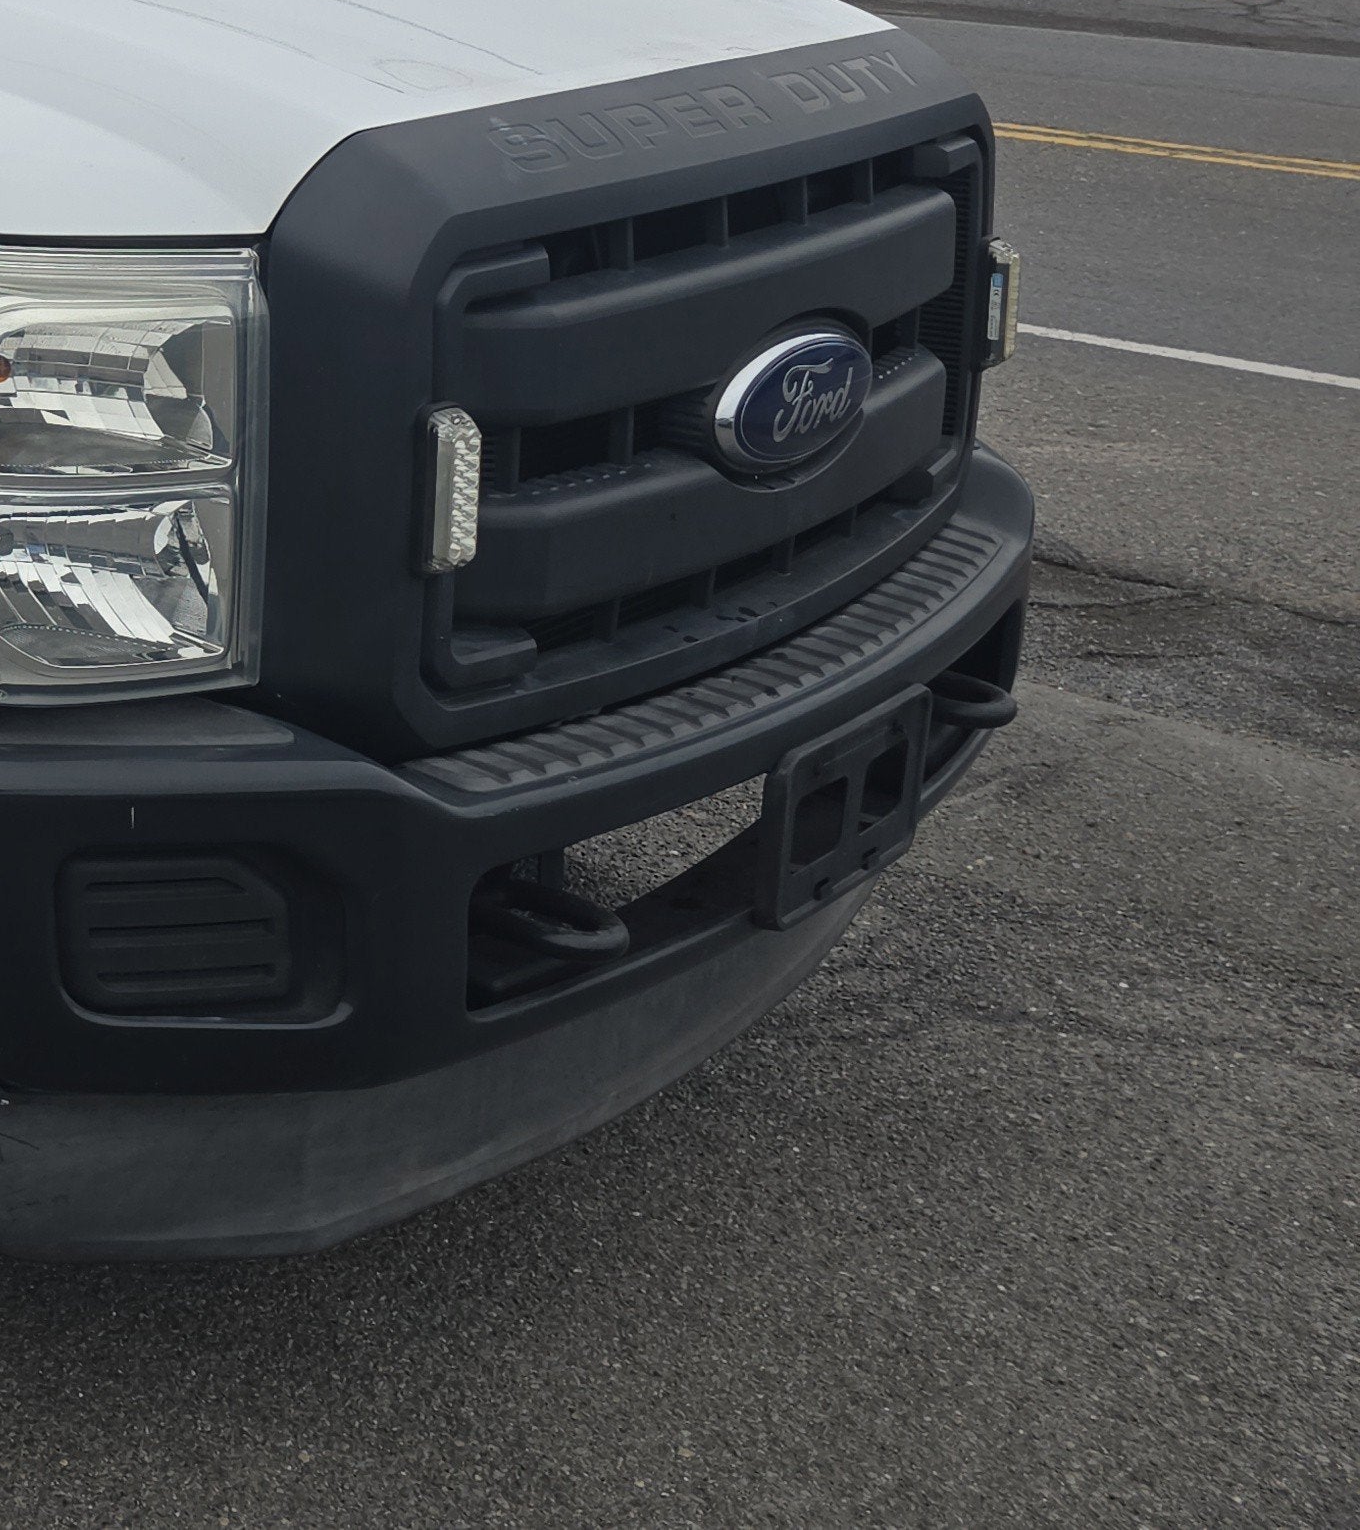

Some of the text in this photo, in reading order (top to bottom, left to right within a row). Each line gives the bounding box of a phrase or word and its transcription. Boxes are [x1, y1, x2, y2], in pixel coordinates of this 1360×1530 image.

[488, 48, 919, 174] SUPER DUTY
[772, 357, 854, 443] Ford
